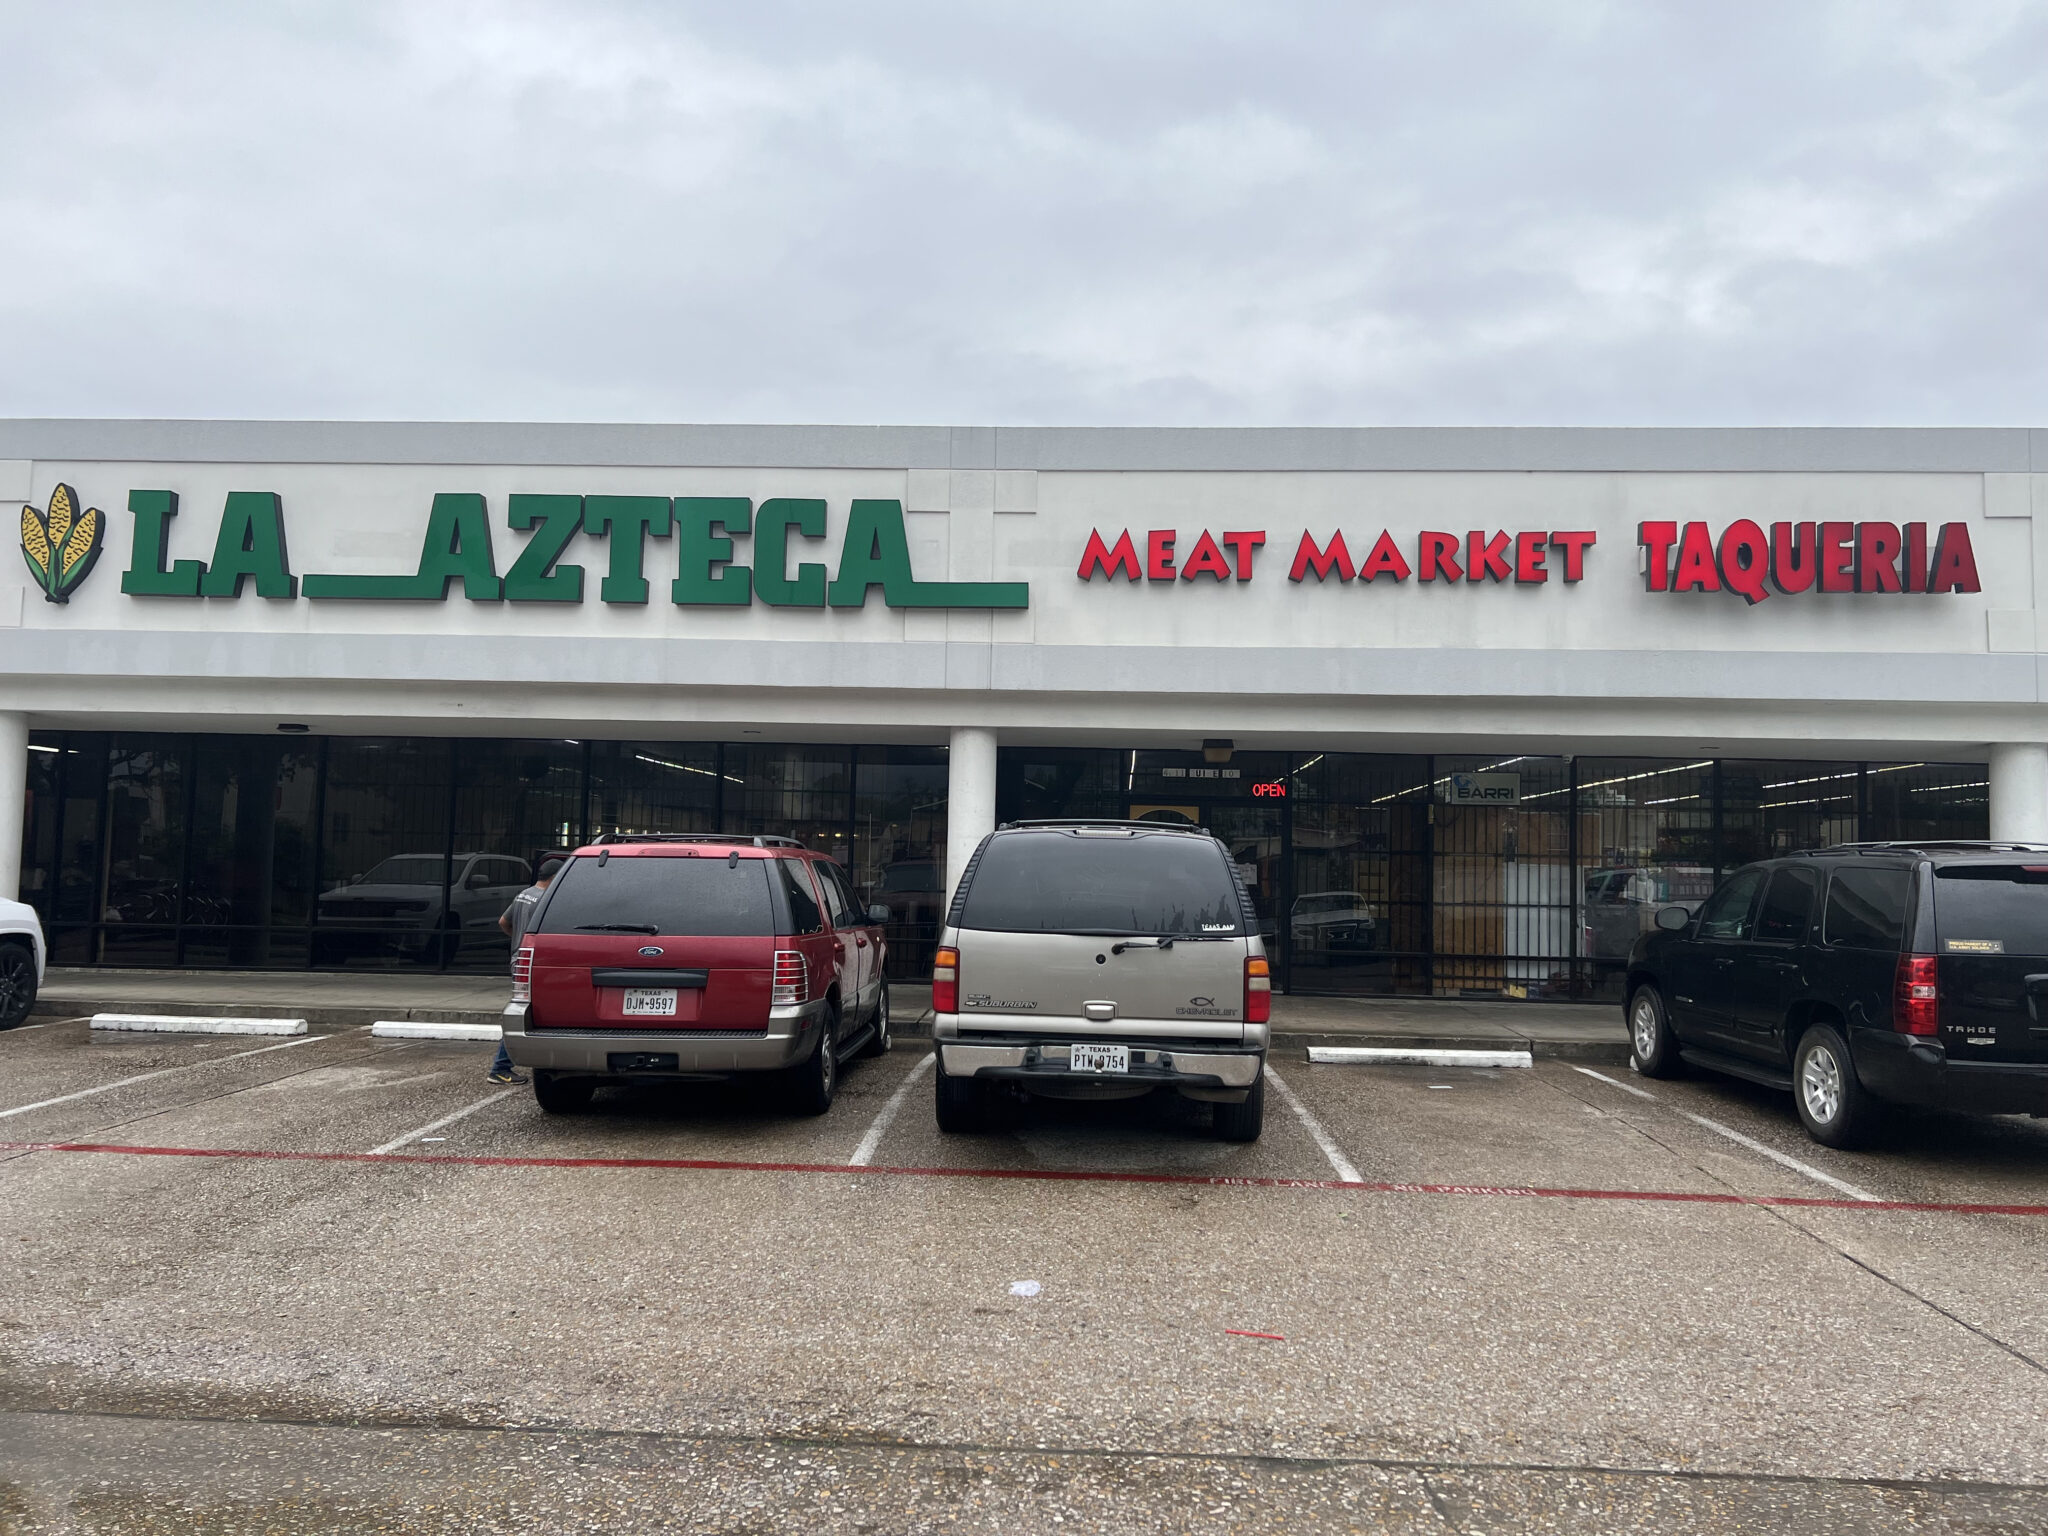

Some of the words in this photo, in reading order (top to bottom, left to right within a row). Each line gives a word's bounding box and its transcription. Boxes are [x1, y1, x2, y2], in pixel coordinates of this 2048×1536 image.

[121, 489, 298, 599] LA
[301, 493, 1029, 609] AZTECA
[1077, 527, 1266, 582] MEAT
[1288, 528, 1597, 584] MARKET
[1638, 518, 1982, 606] TAQUERIA
[1252, 783, 1286, 797] OPEN
[1457, 787, 1514, 799] BARRI
[977, 1000, 1038, 1009] SUBURBAN
[1946, 1025, 1997, 1034] TAHOE
[1392, 1184, 1424, 1192] NO
[1436, 1185, 1538, 1196] PARKING
